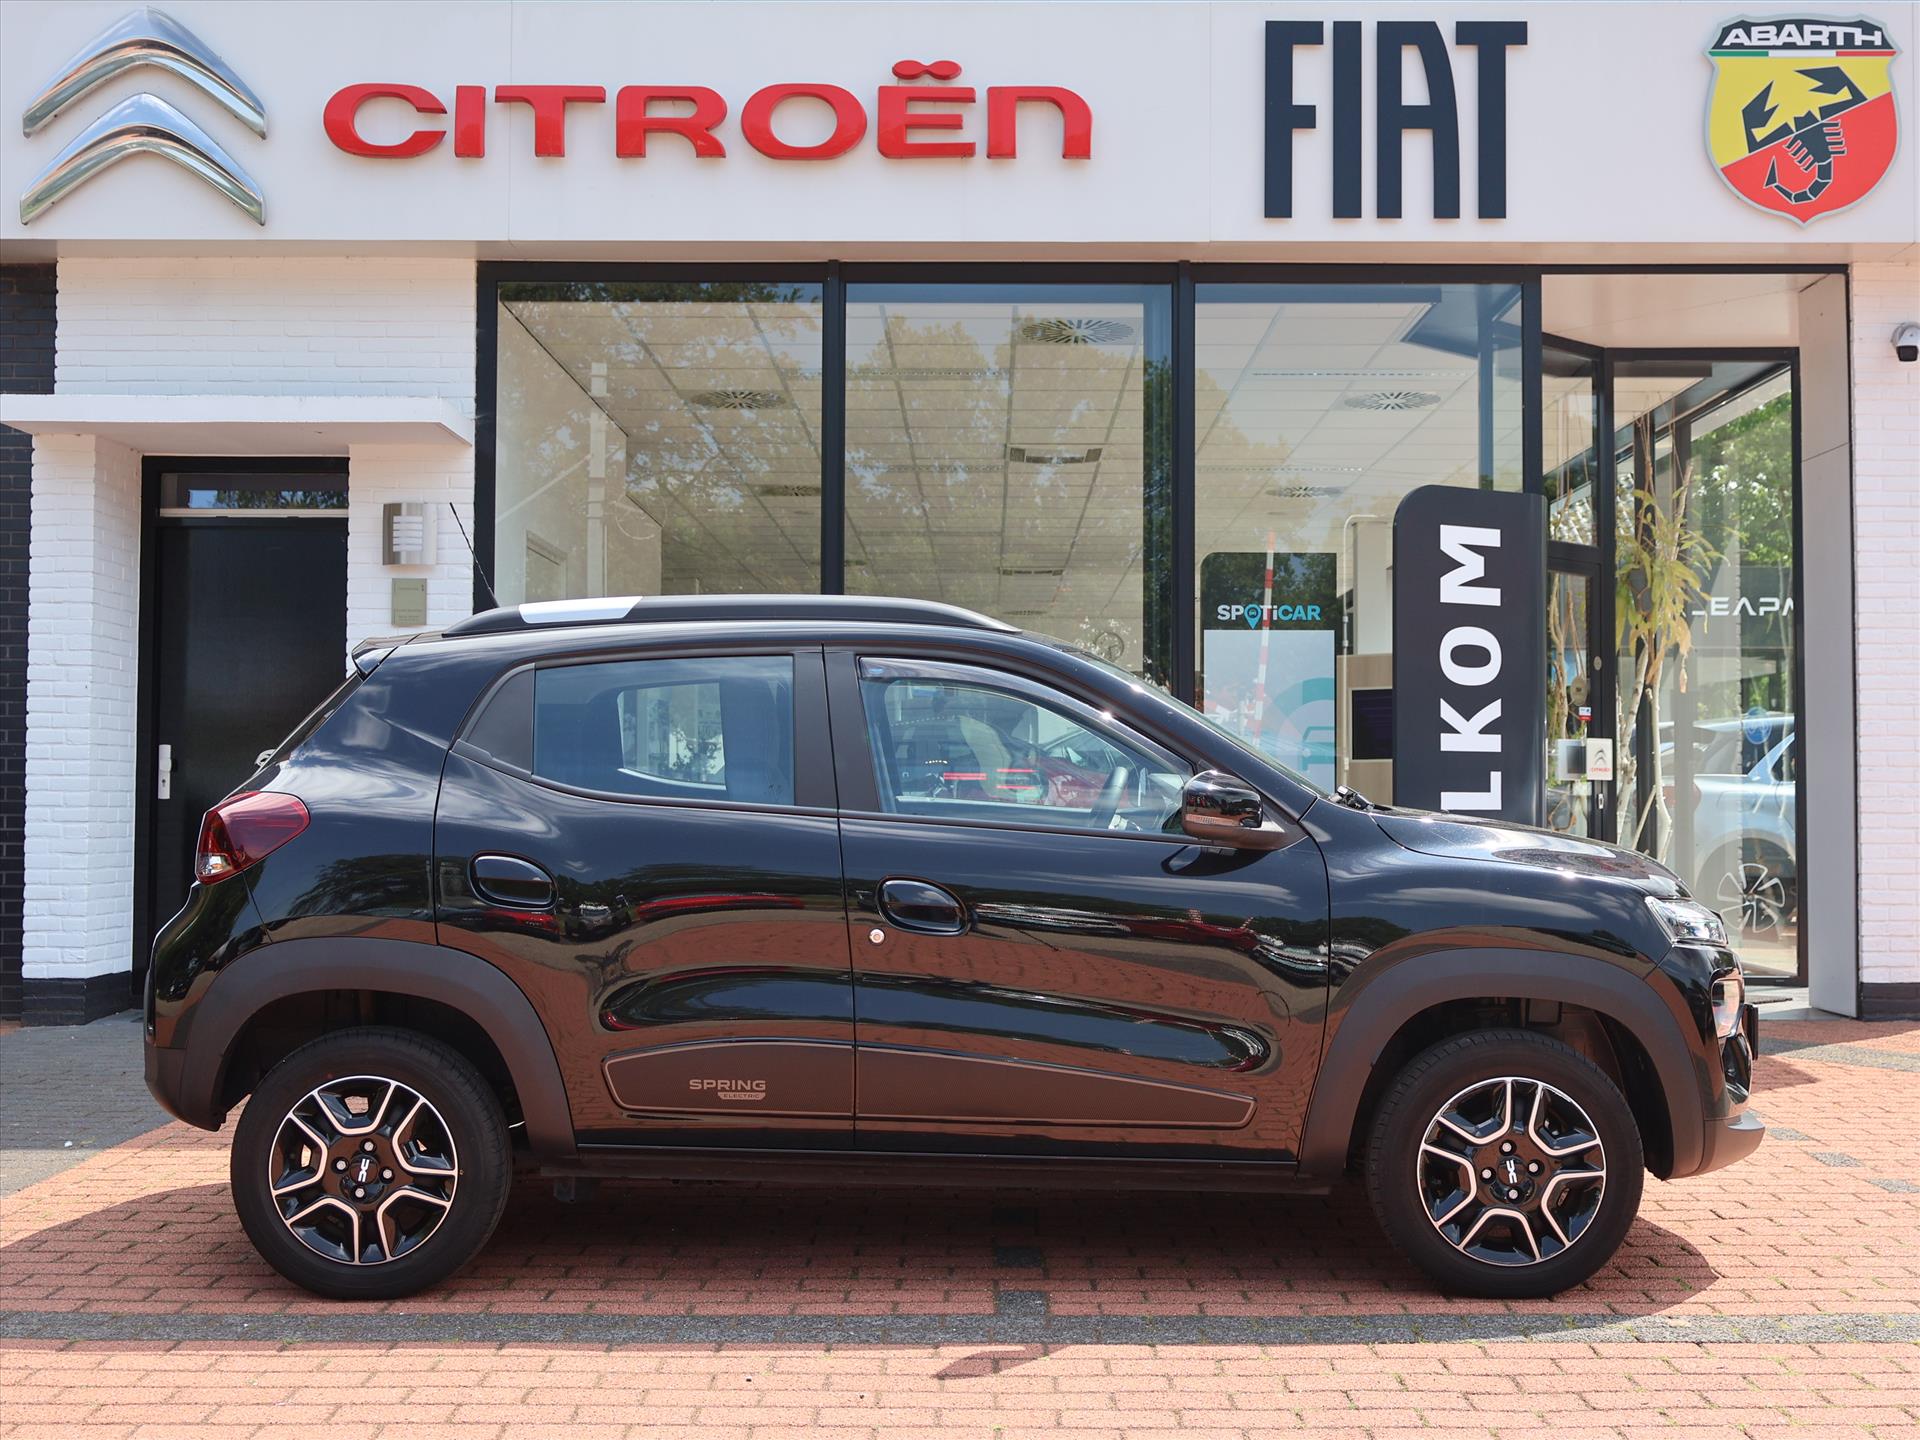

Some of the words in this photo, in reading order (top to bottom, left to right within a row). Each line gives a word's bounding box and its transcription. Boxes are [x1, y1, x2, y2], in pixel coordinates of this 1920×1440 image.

[1722, 24, 1882, 46] ABARTH
[1264, 20, 1528, 219] FIAT
[1439, 524, 1502, 811] LKOM
[689, 1079, 766, 1091] SPRING
